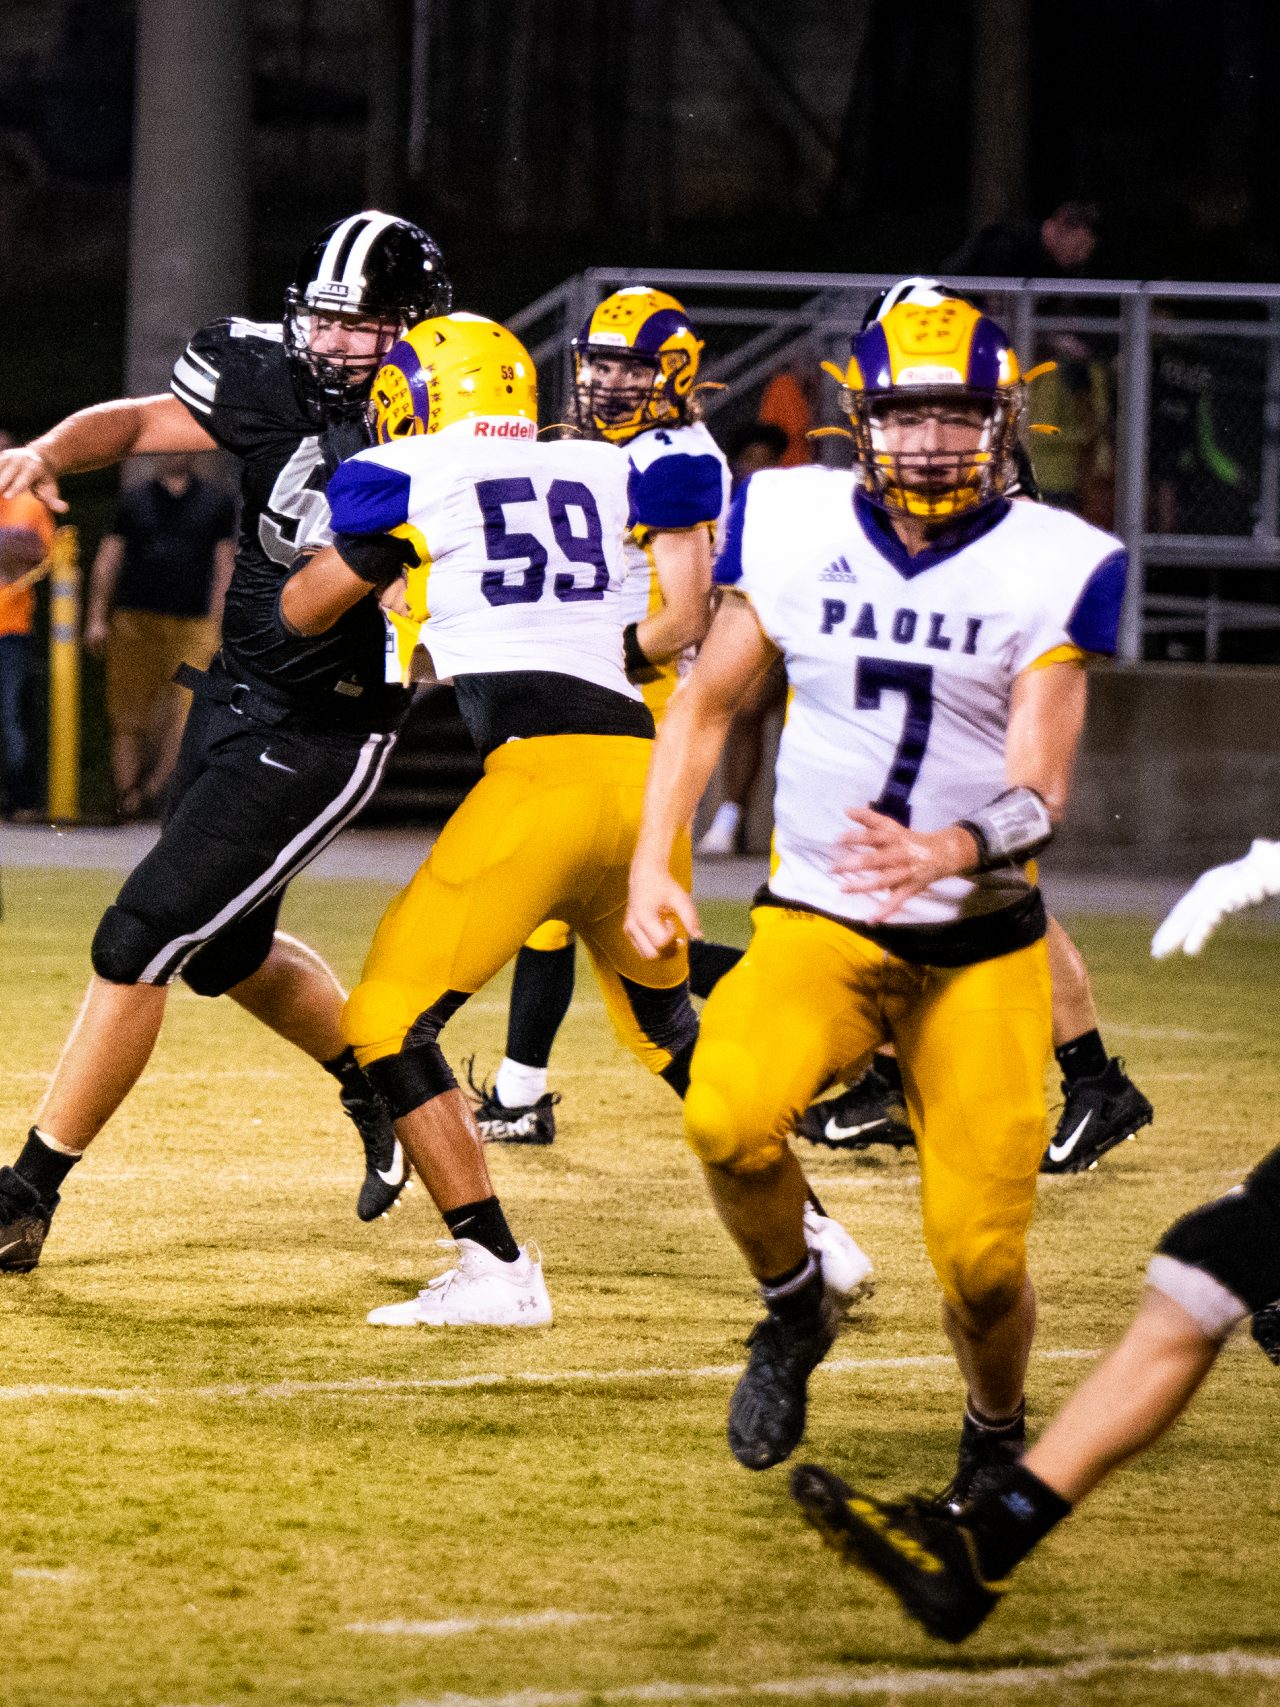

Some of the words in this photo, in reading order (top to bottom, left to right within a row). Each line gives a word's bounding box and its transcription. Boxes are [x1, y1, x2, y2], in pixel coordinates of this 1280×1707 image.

[474, 421, 534, 439] Riddell
[474, 476, 610, 607] 59
[819, 598, 983, 656] PAOLI
[855, 655, 933, 829] 7
